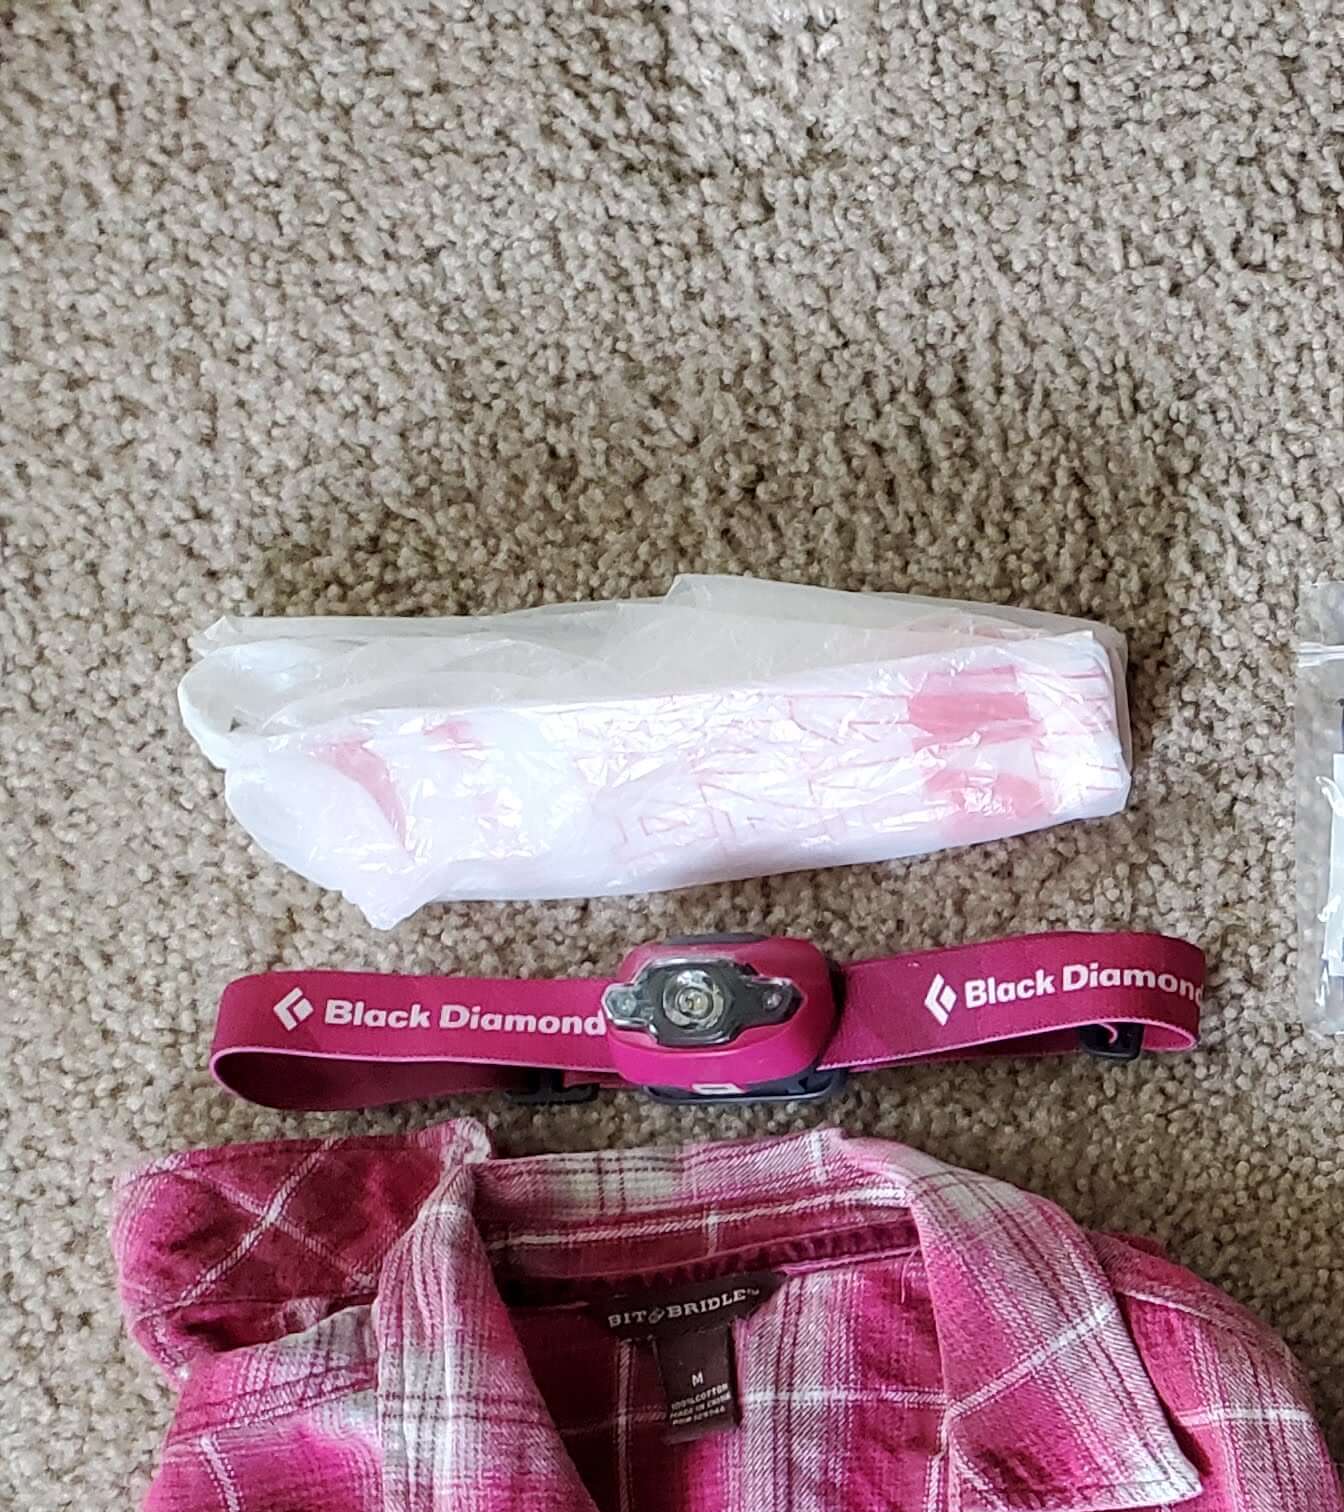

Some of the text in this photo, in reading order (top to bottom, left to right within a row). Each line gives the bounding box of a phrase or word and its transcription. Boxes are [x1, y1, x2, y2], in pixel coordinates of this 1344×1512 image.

[964, 968, 1056, 1009] Black
[324, 999, 608, 1037] Black Diamond
[692, 1371, 704, 1387] M
